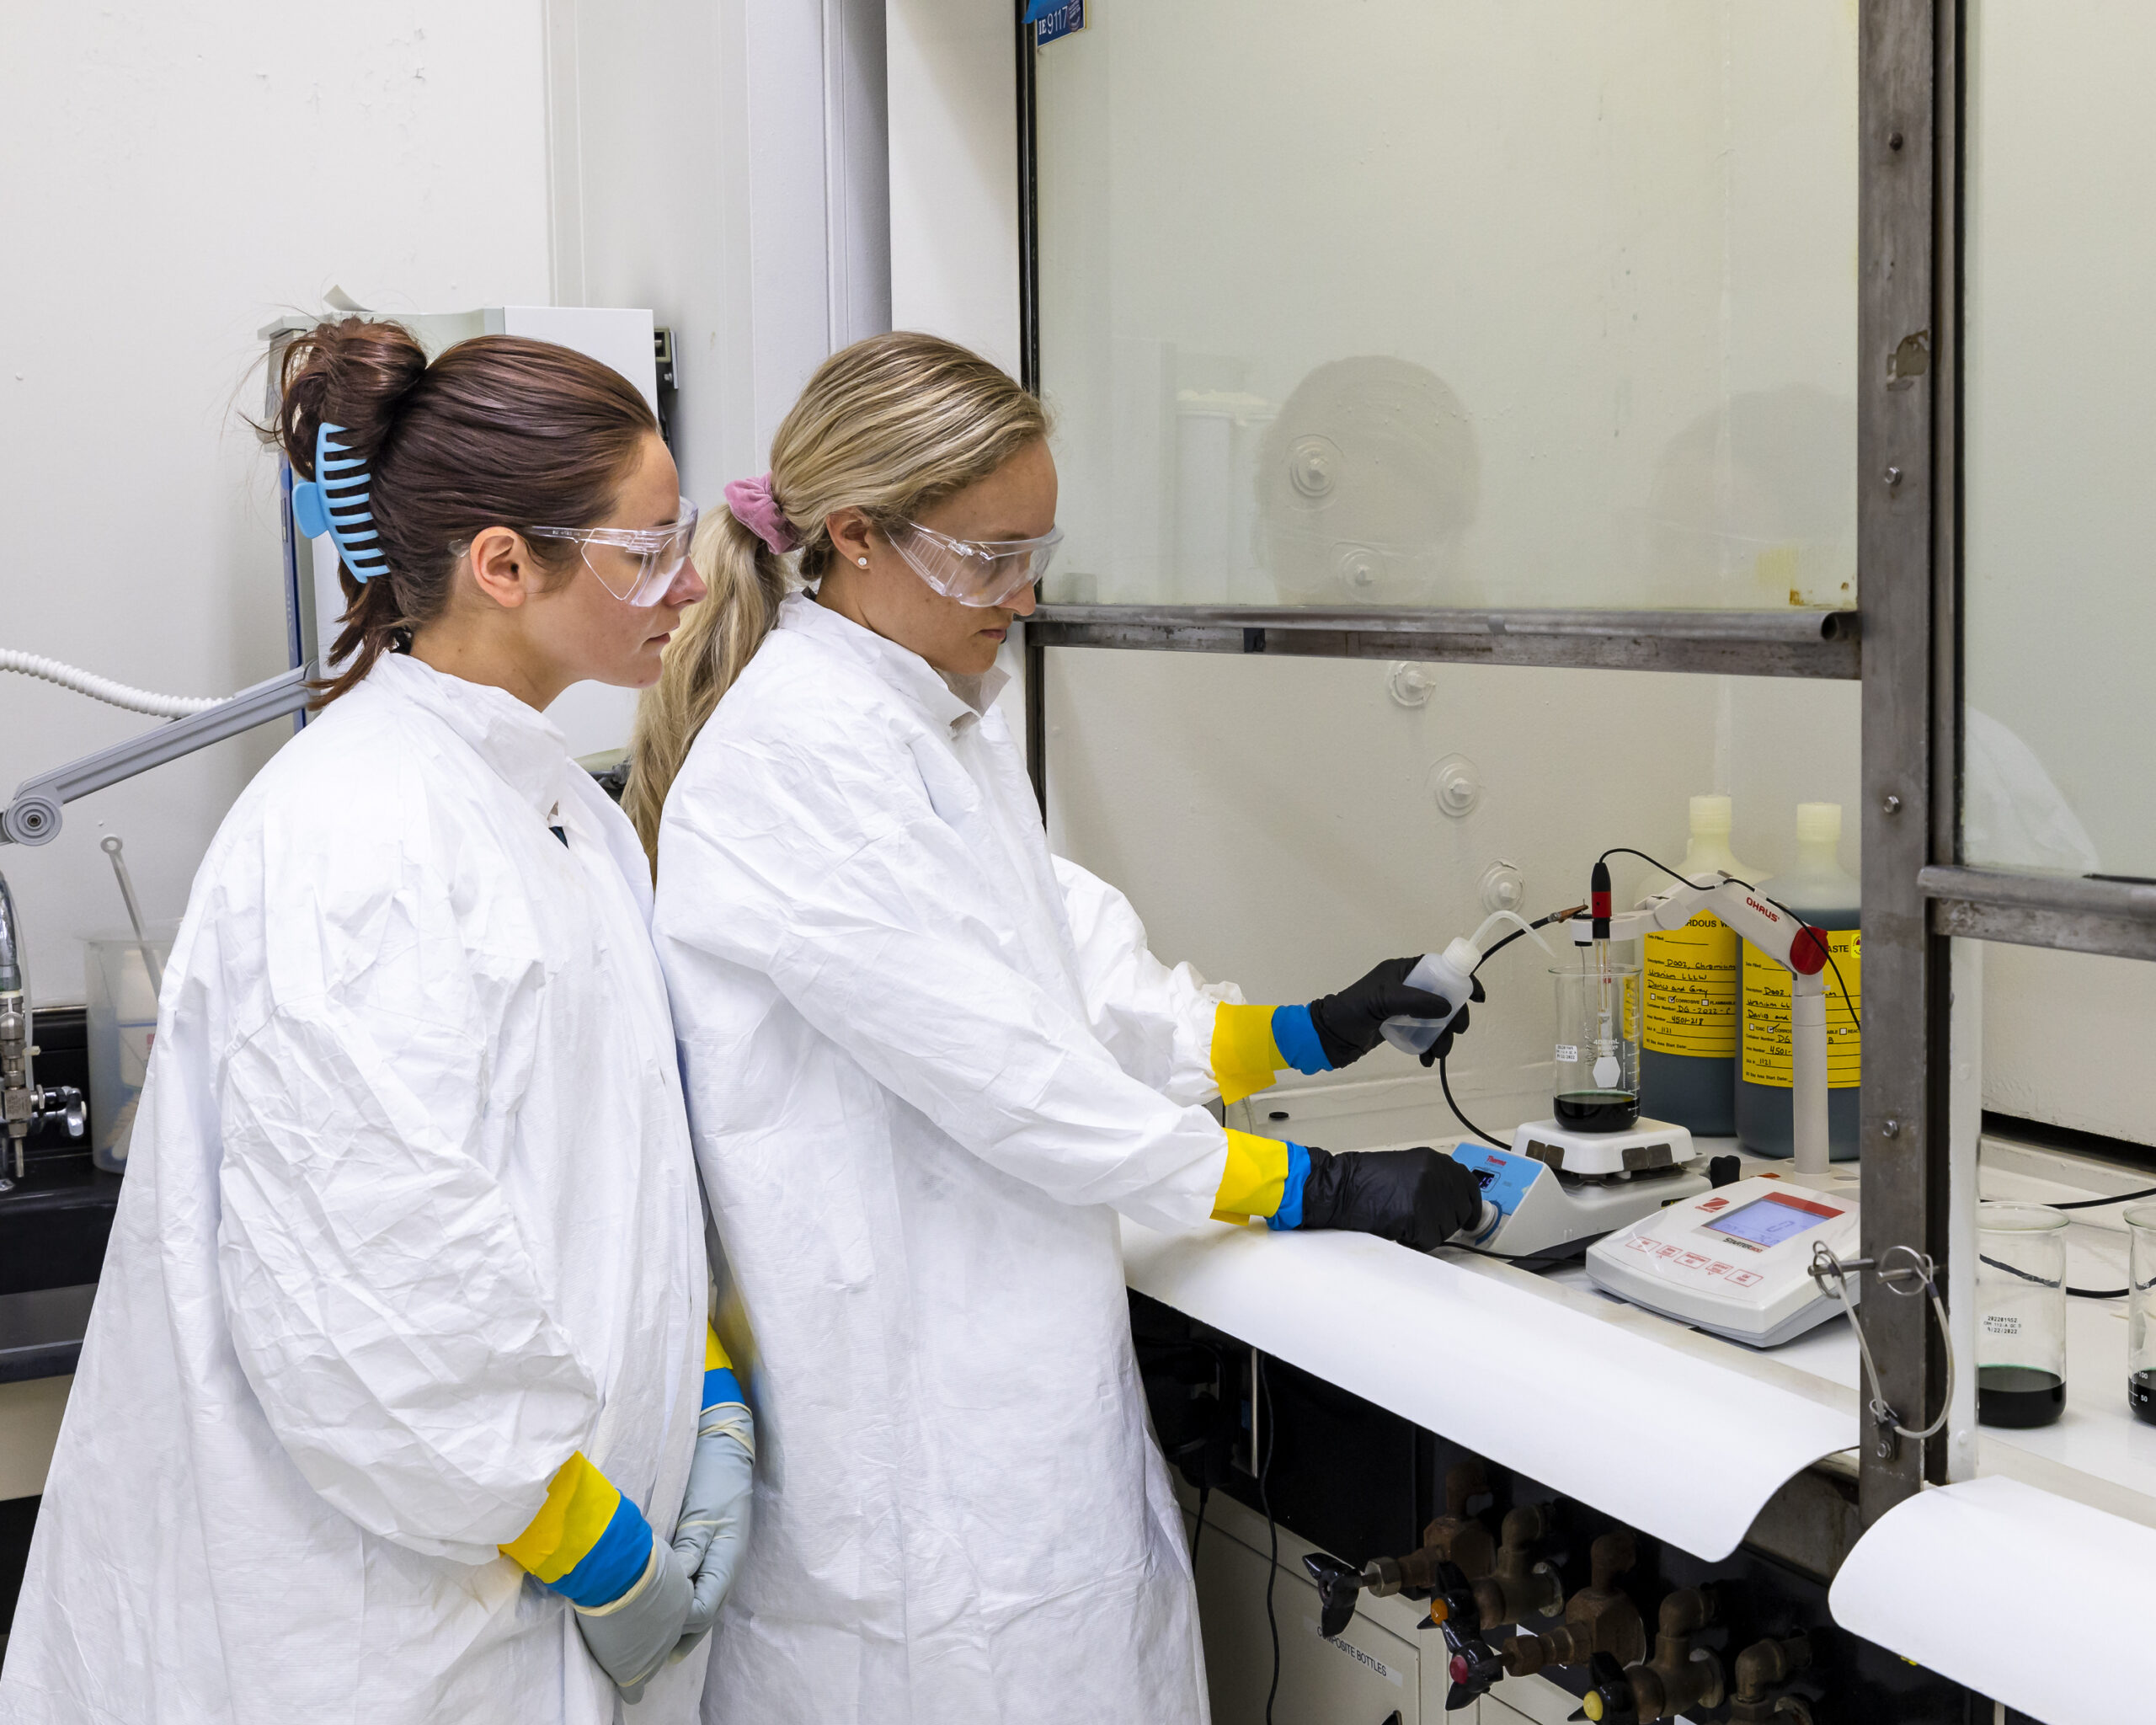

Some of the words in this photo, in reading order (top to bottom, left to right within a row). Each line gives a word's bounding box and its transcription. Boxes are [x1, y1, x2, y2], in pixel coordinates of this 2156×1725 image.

[1746, 896, 1778, 922] OHAUS
[1686, 919, 1717, 927] RDOUS
[1828, 945, 1849, 953] ASTE
[1769, 1045, 1792, 1055] 4501-
[2141, 1394, 2148, 1402] 50
[1317, 1626, 1356, 1658] CPOSITE
[1356, 1649, 1387, 1676] BOTTLES
